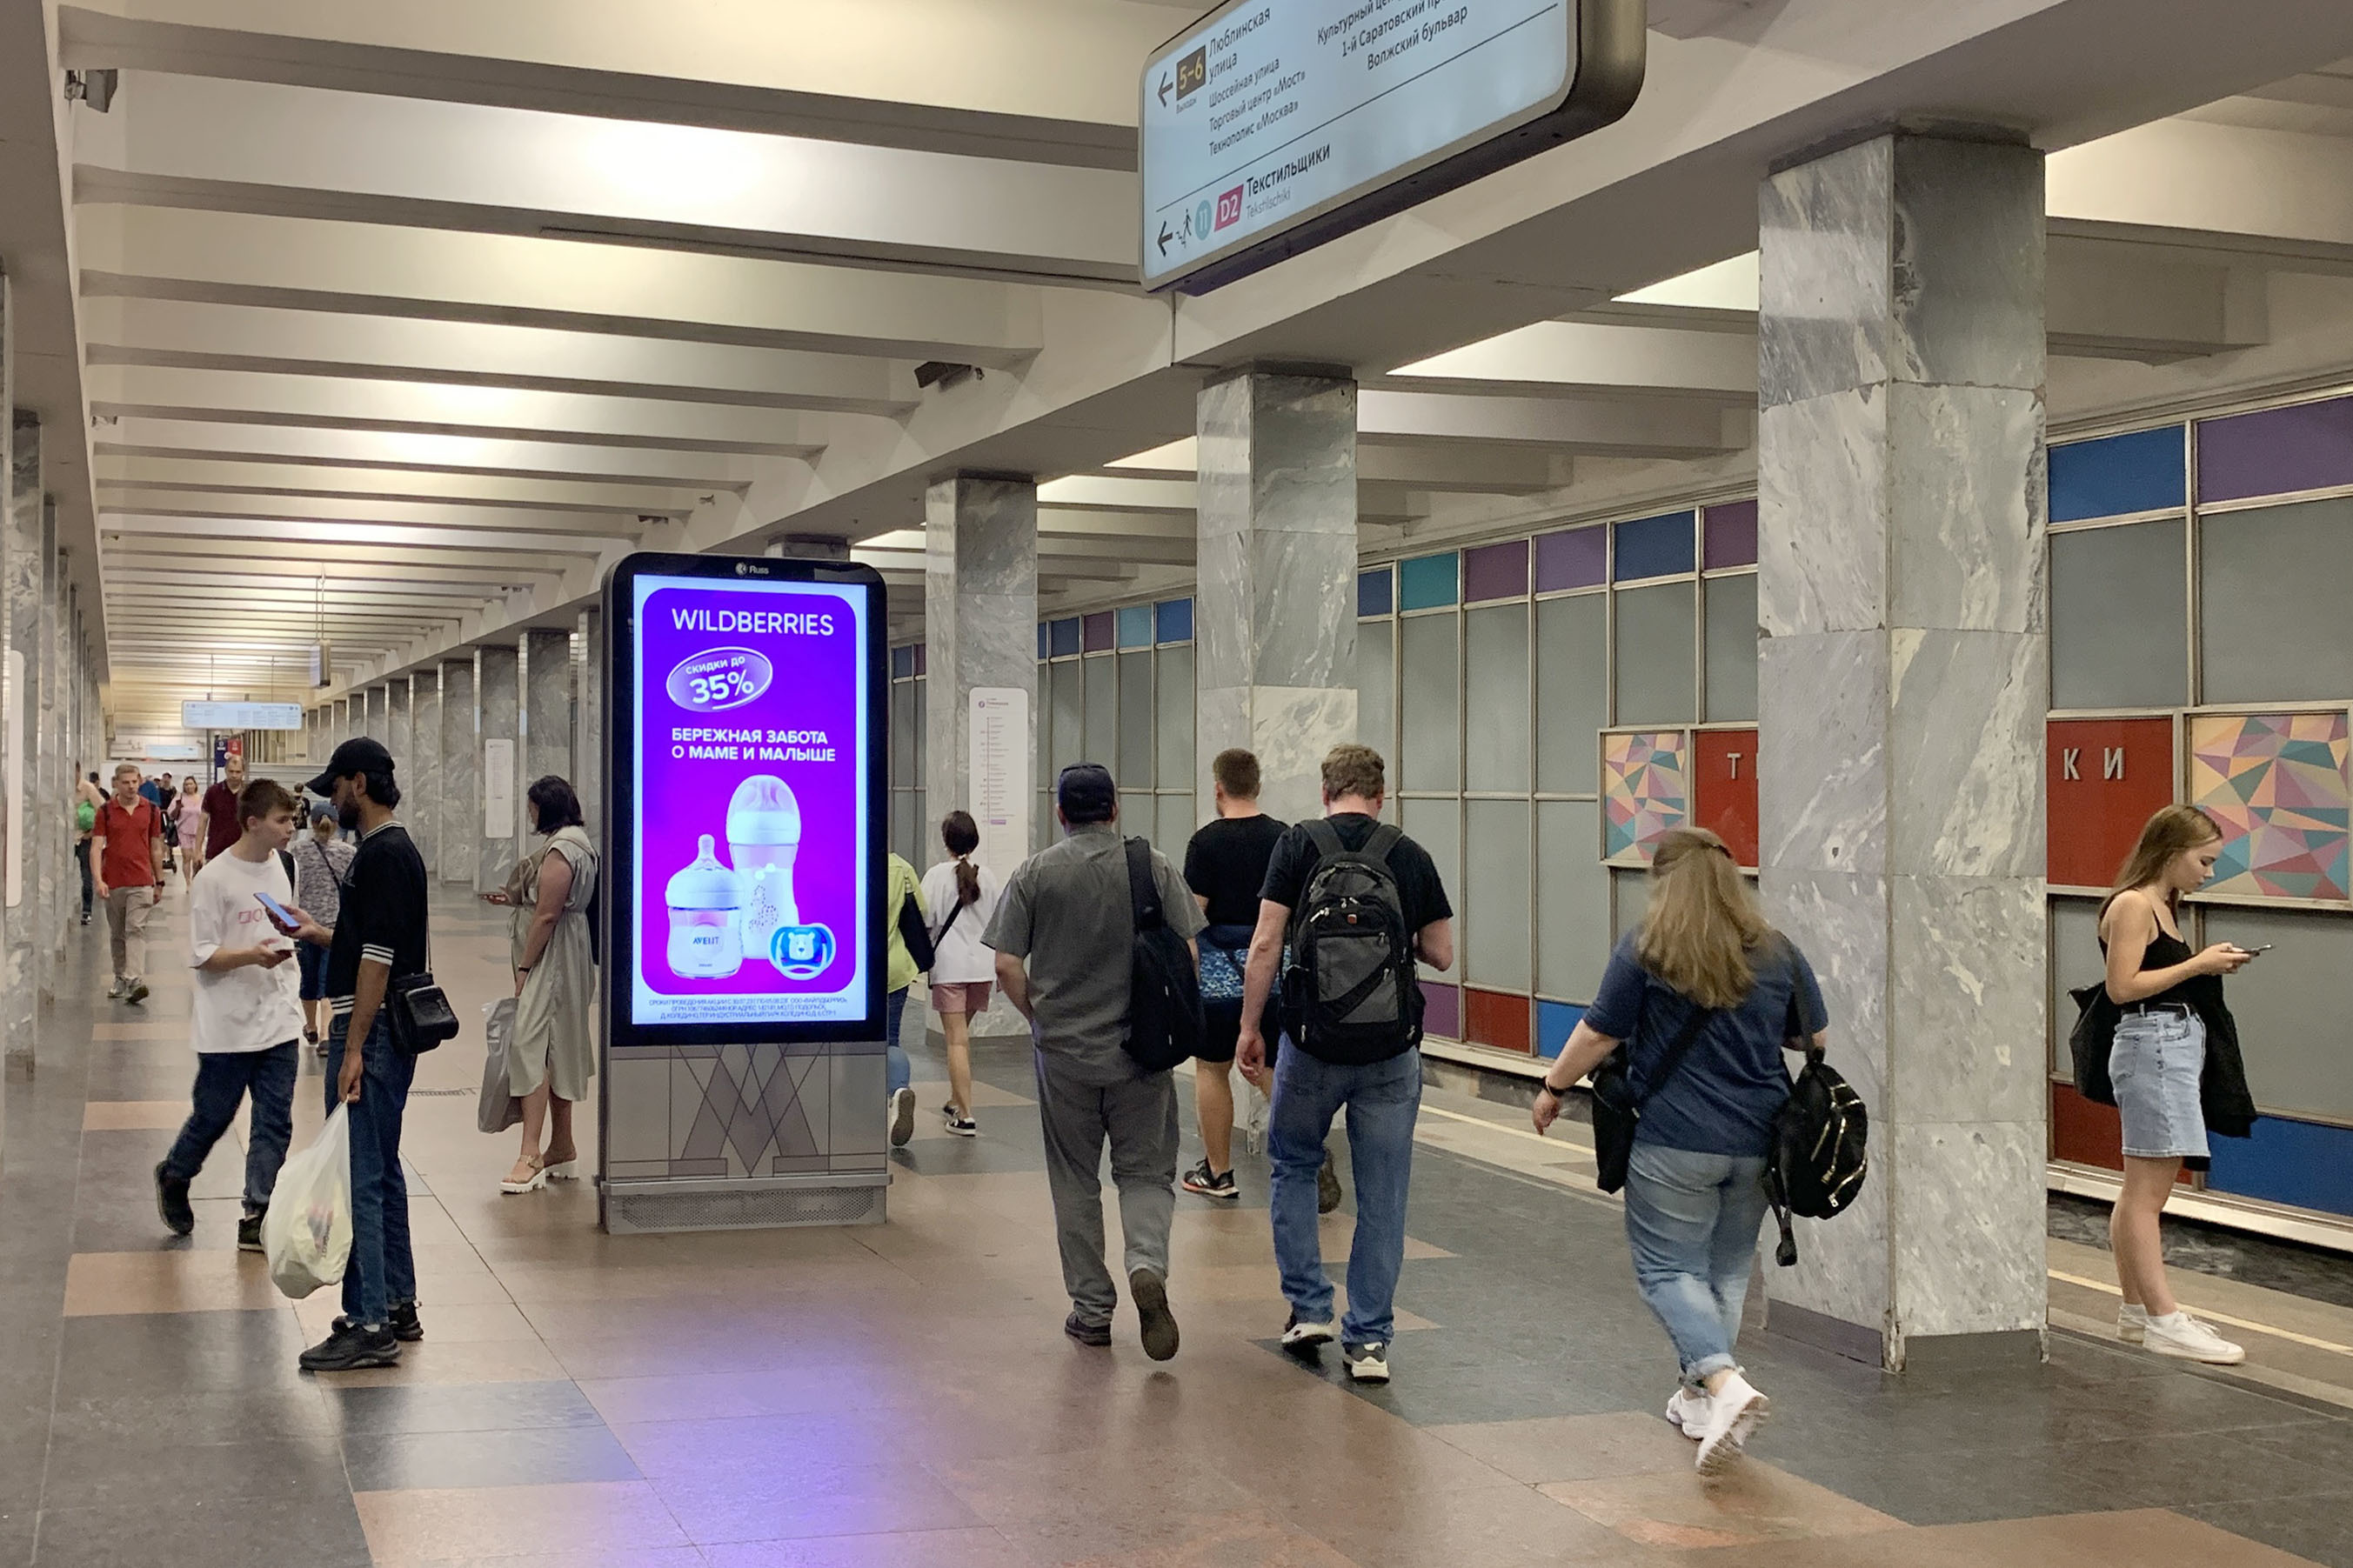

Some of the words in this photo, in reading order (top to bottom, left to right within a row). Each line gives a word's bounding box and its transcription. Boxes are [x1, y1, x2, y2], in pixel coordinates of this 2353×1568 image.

[1209, 8, 1271, 57] Люблинская
[1317, 0, 1373, 44] Культурный
[1342, 36, 1357, 57] 1-й
[1359, 0, 1425, 46] Саратовский
[1367, 29, 1419, 70] Волжский
[1421, 6, 1467, 42] бульвар
[1180, 56, 1204, 90] 5-6
[1209, 53, 1238, 84] улица
[1209, 74, 1253, 108] Шоссейная
[1254, 58, 1280, 90] улица
[1209, 101, 1246, 131] Торговый
[1247, 87, 1272, 112] центр
[1273, 70, 1306, 97] «Мост»
[1209, 123, 1254, 157] Технополис
[1257, 101, 1299, 131] «Москва»
[1247, 144, 1330, 197] Текстильщики
[1220, 194, 1239, 224] D2
[749, 565, 769, 575] Russ
[672, 608, 834, 637] WILDBERRIES
[690, 669, 754, 704] 35%
[672, 727, 762, 744] БЕРЕЖНАЯ
[766, 730, 828, 744] ЗАБОТА
[672, 745, 685, 758] О
[689, 745, 738, 760] МАМЕ
[743, 746, 754, 760] И
[759, 747, 836, 762] МАЛЫШЕ
